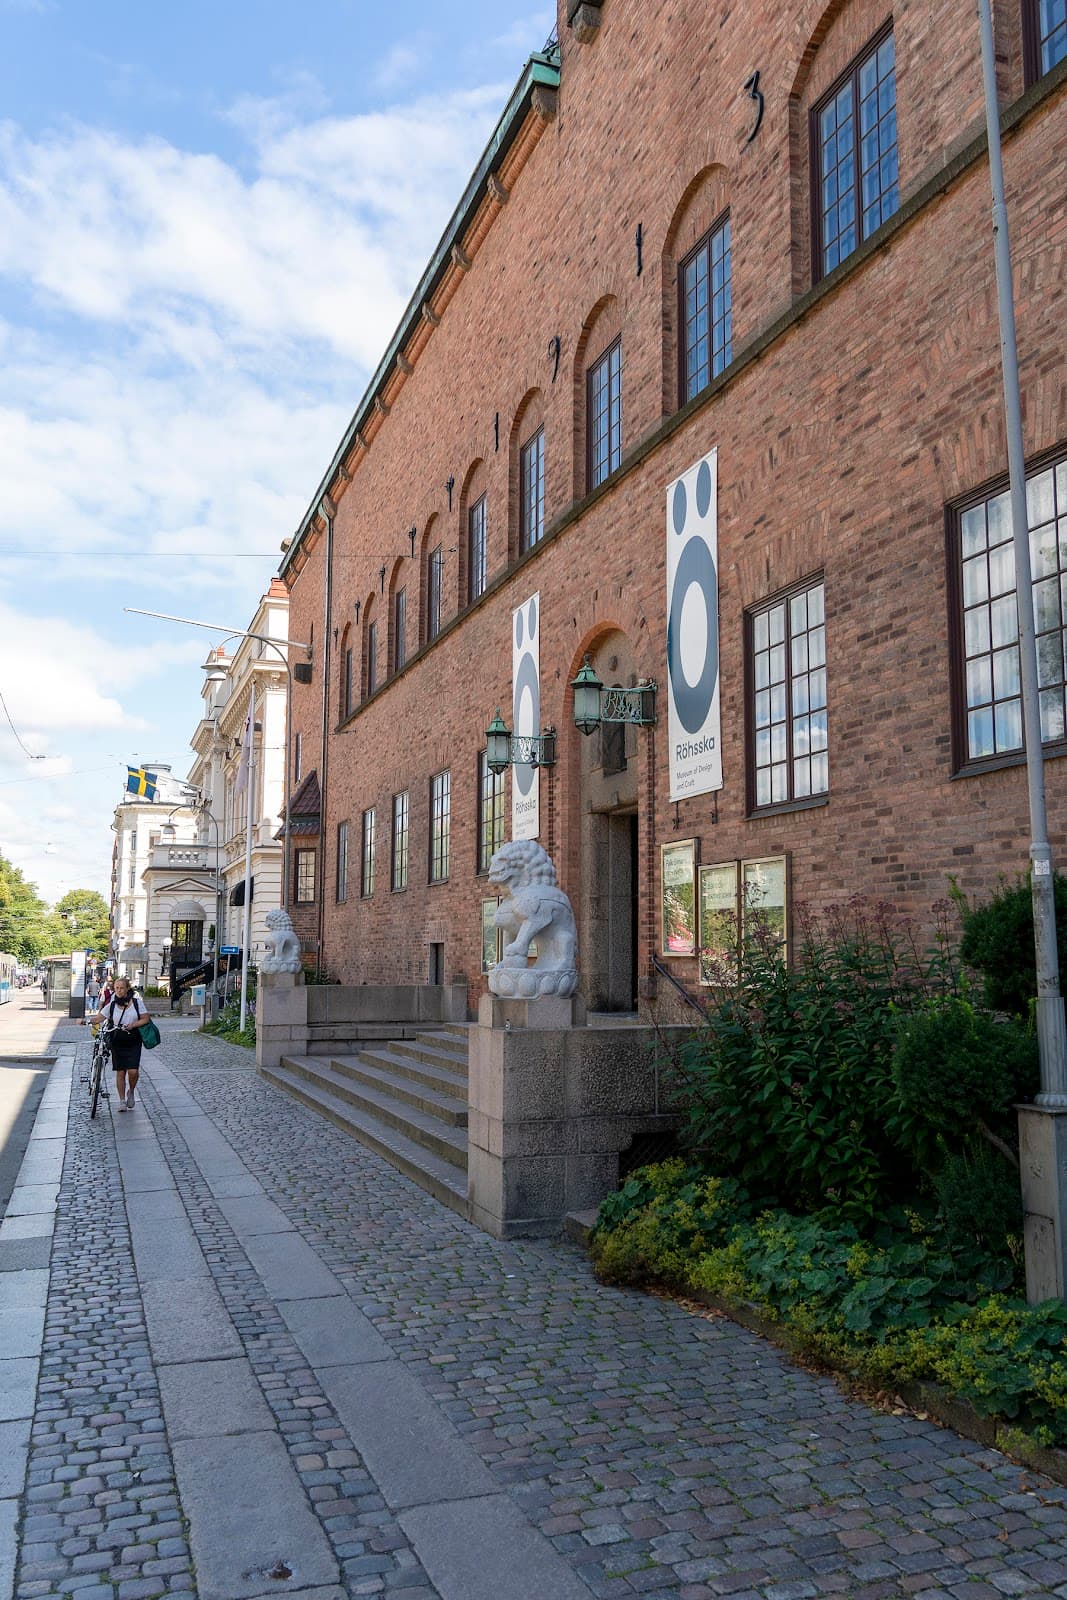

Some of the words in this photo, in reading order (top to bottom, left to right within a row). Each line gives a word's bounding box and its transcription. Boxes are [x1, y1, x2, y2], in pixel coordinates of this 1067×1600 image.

[676, 735, 715, 761] Röhsska
[676, 770, 692, 779] Museum
[698, 763, 712, 773] Design
[684, 779, 695, 788] Craft
